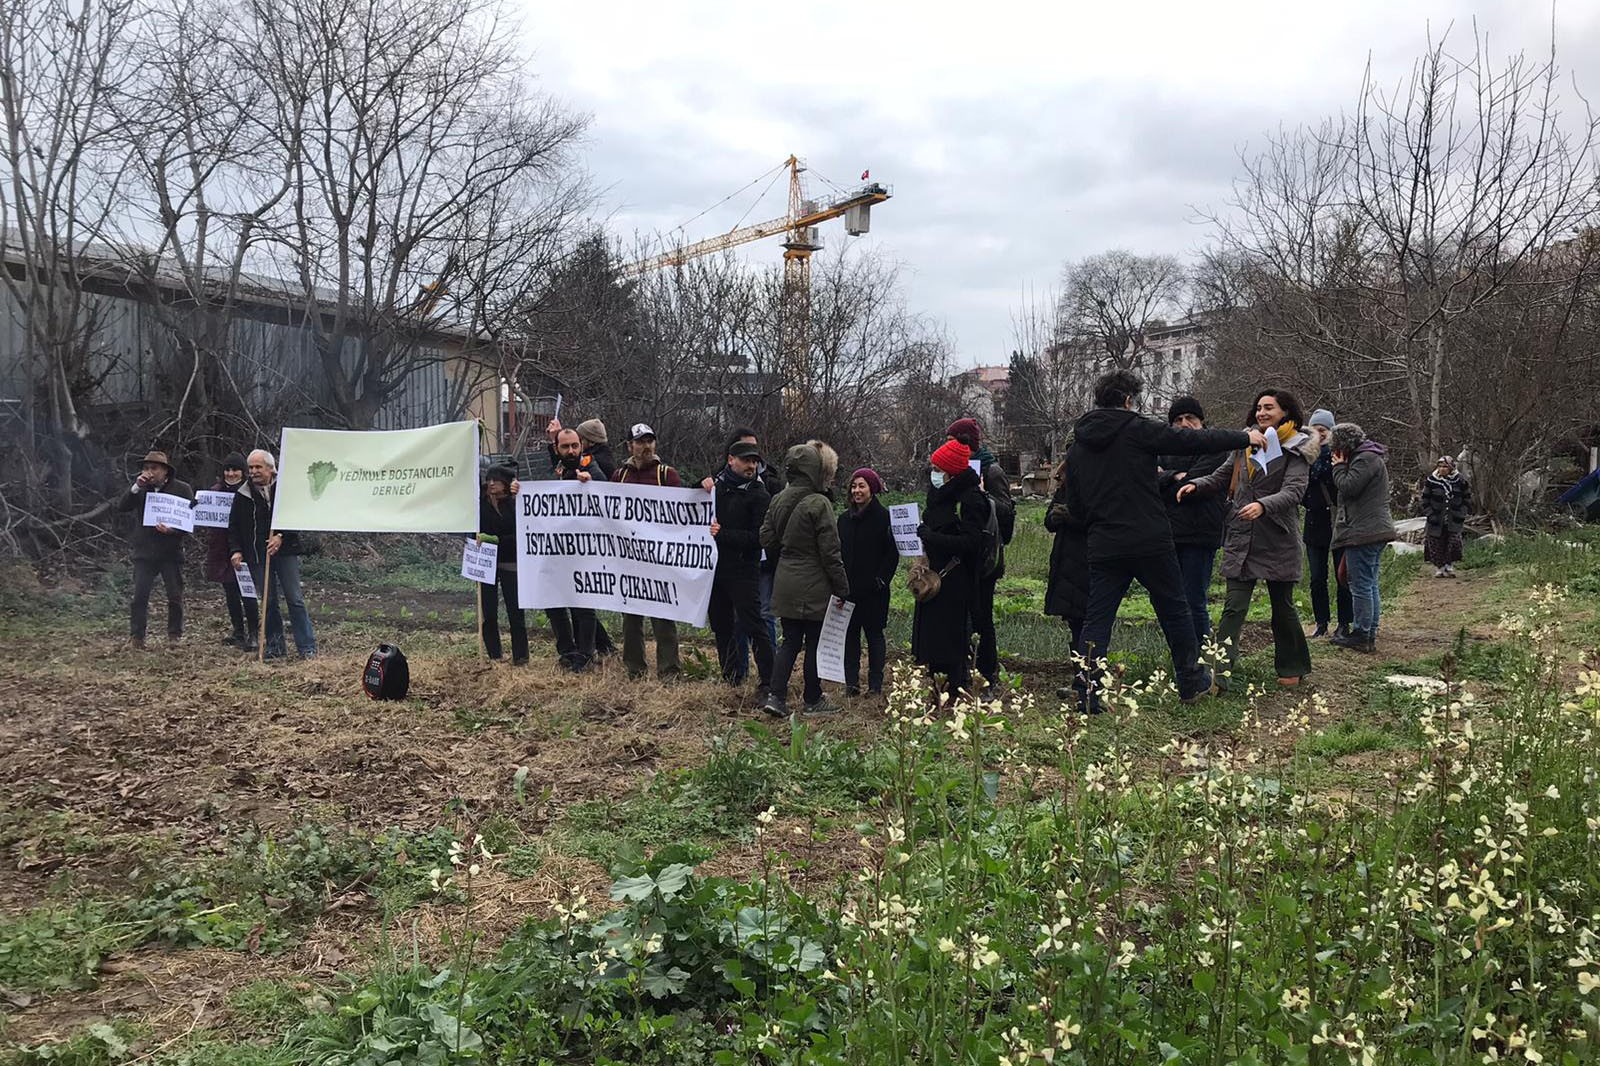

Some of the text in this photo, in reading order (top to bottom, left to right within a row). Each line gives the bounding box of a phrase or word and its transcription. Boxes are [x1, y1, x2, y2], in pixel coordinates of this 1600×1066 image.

[339, 465, 454, 482] YEDİKULE BOSTANCILAR
[372, 482, 417, 496] DERNEĞİ
[522, 493, 603, 518] BOSTANLAR
[604, 494, 621, 520] VE
[526, 525, 616, 557] İSTANBUL'UN
[616, 530, 714, 571] DEĞERLERİDİR
[574, 565, 616, 596] SAHİP
[620, 573, 673, 605] ÇIKALIM
